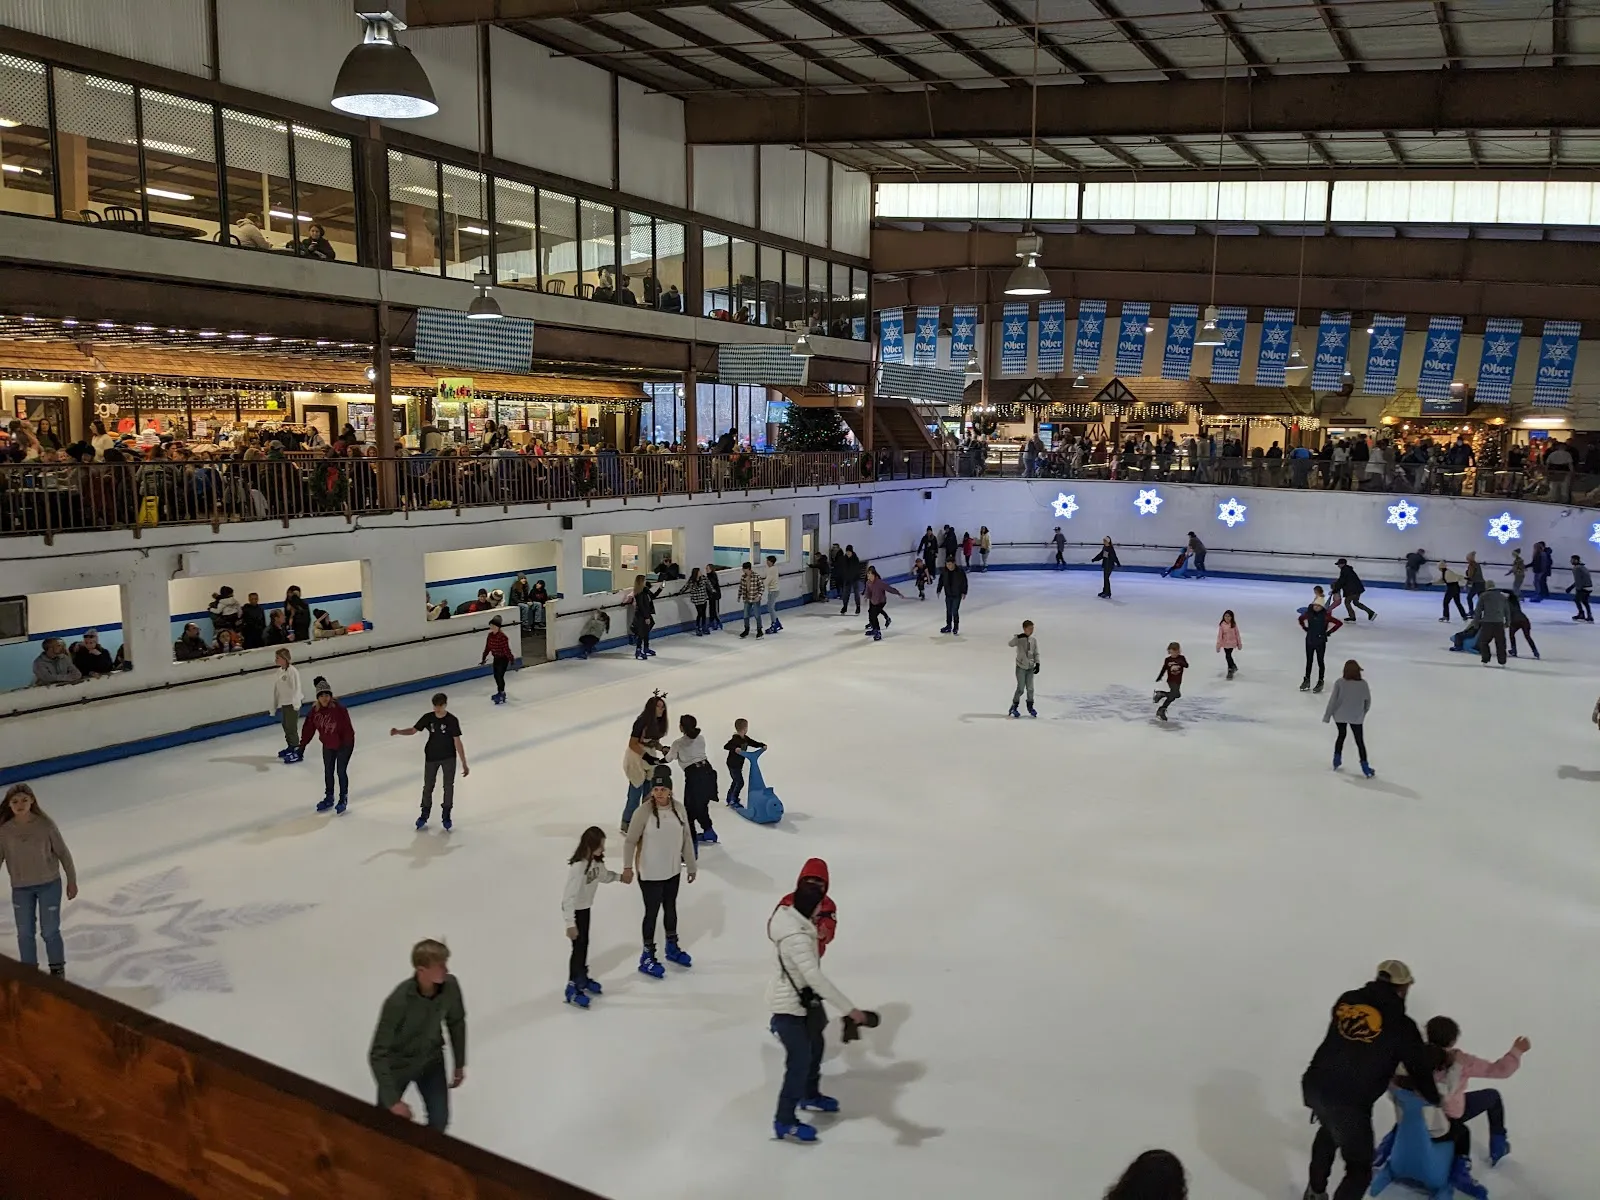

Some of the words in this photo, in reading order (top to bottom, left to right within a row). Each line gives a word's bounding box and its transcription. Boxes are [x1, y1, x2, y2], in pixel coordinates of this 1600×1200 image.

[915, 342, 936, 351] Ober
[953, 341, 974, 351] Ober
[1004, 341, 1025, 350] Ober
[1040, 339, 1062, 348] Ober
[1077, 339, 1100, 348] Ober
[1119, 341, 1143, 352] Ober
[883, 344, 902, 354] Ober
[1167, 344, 1191, 354] Ober
[1215, 348, 1240, 357] Ober
[1261, 350, 1287, 360] Ober
[1317, 353, 1344, 363] Ober
[1369, 356, 1397, 367] Ober
[1424, 359, 1454, 371] Ober
[1482, 362, 1512, 374] Ober
[1540, 366, 1571, 377] Ober
